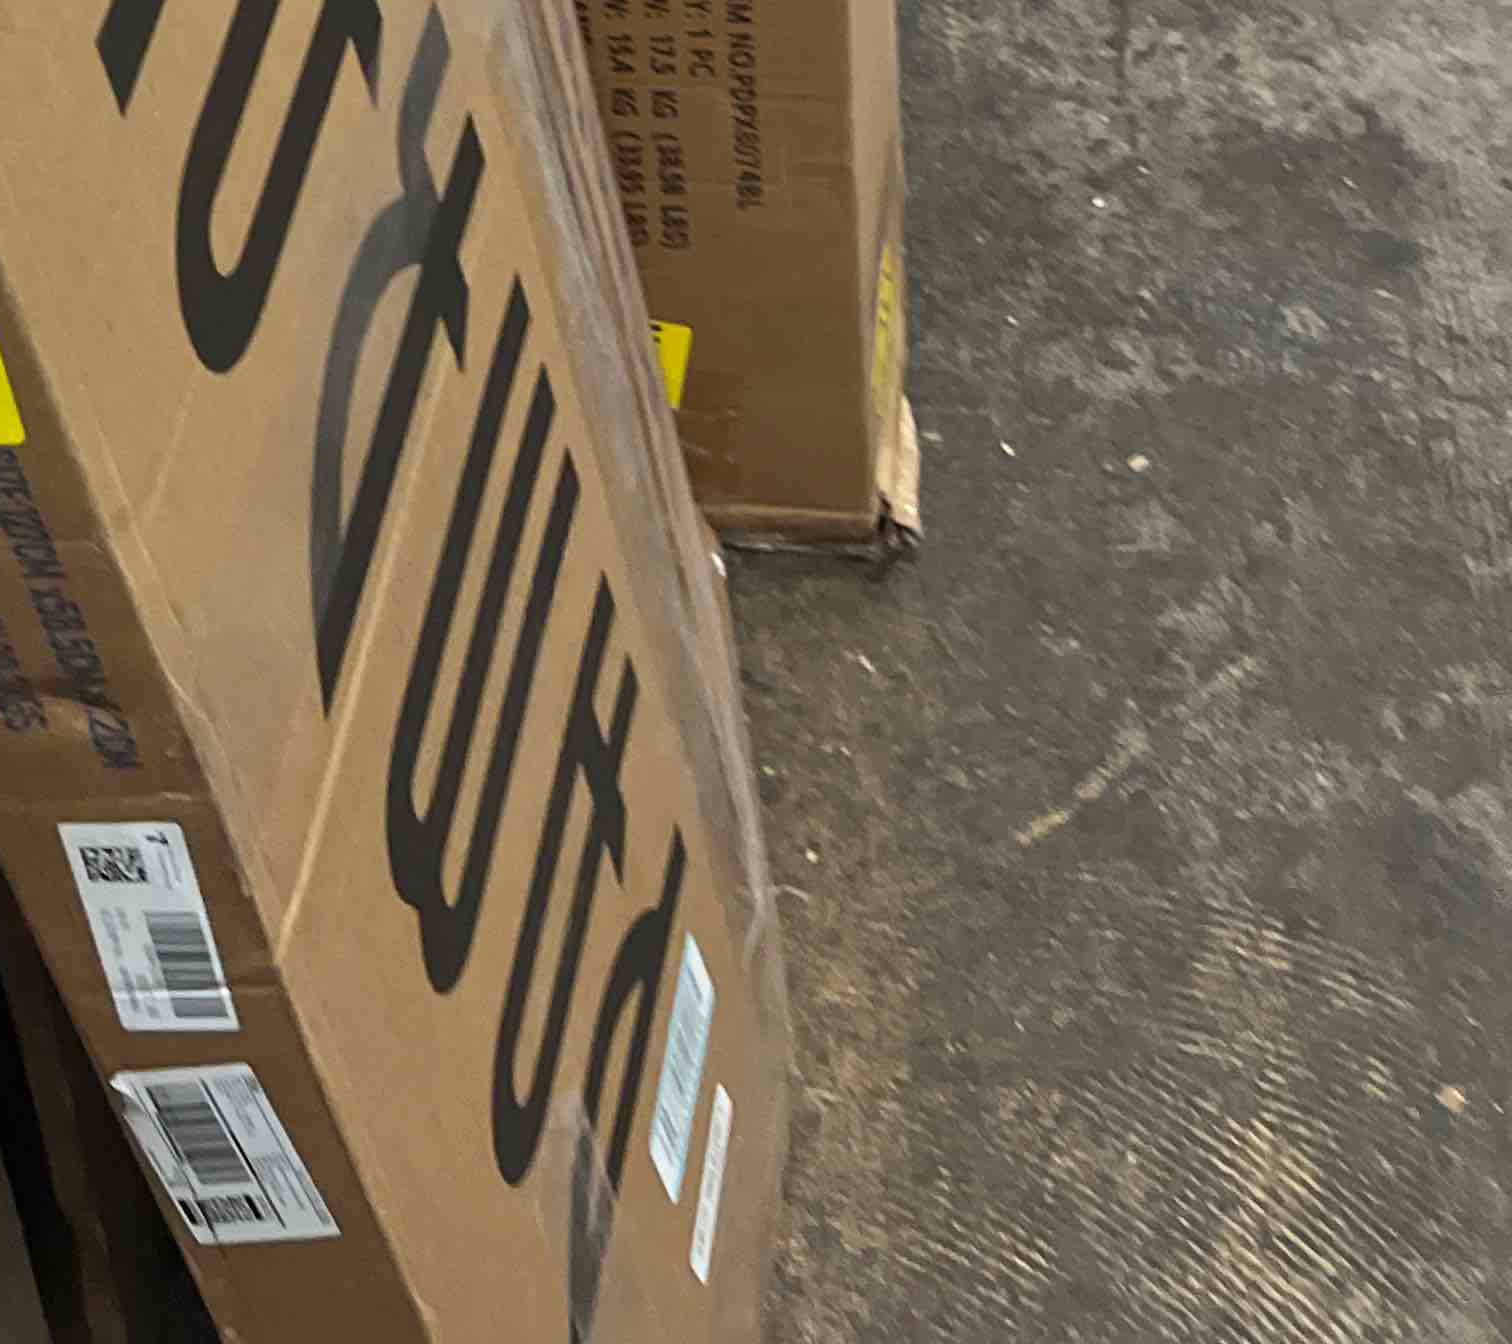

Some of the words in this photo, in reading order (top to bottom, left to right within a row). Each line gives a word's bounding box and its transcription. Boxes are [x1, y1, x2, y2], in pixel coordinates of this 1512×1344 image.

[686, 28, 715, 39] 1
[687, 48, 717, 79] PC
[610, 88, 639, 118] KG
[650, 88, 681, 120] KG
